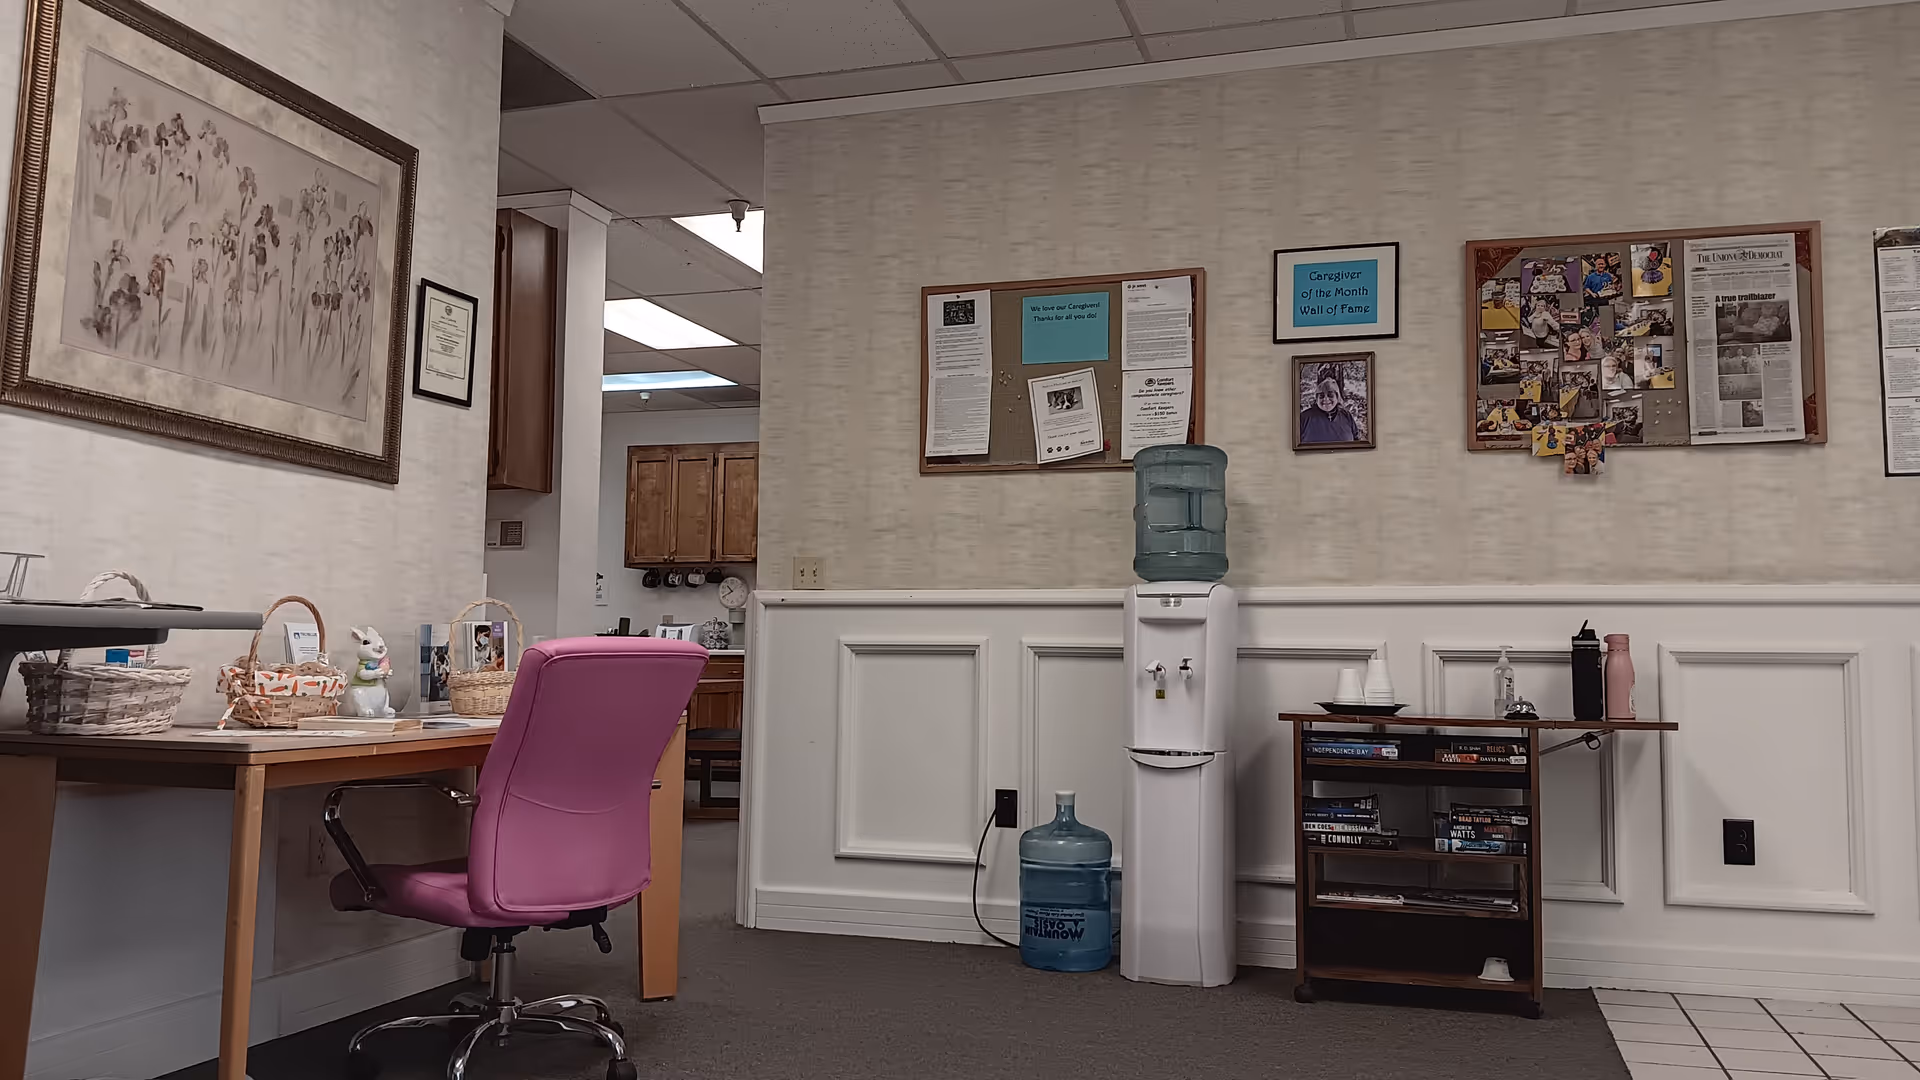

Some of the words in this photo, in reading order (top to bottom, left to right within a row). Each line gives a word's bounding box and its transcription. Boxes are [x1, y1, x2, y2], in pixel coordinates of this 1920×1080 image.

[1697, 253, 1711, 263] THE
[1713, 252, 1734, 262] UNION
[1748, 251, 1783, 260] DEMOCRAT
[1309, 271, 1362, 282] Caregiver
[1301, 288, 1313, 300] of
[1315, 288, 1331, 298] the
[1335, 286, 1368, 296] Month
[1721, 294, 1737, 302] true
[1738, 293, 1776, 301] trailblazer
[1300, 305, 1323, 315] Wall
[1327, 304, 1338, 316] of
[1341, 304, 1370, 314] Fame
[1312, 747, 1355, 755] INDEPENDENCE
[1486, 745, 1505, 753] RELICS
[1328, 834, 1362, 844] CONNOLLY
[1450, 830, 1476, 839] WATTS
[1034, 919, 1066, 931] OASIS
[1025, 926, 1085, 942] MOUNTAIN
